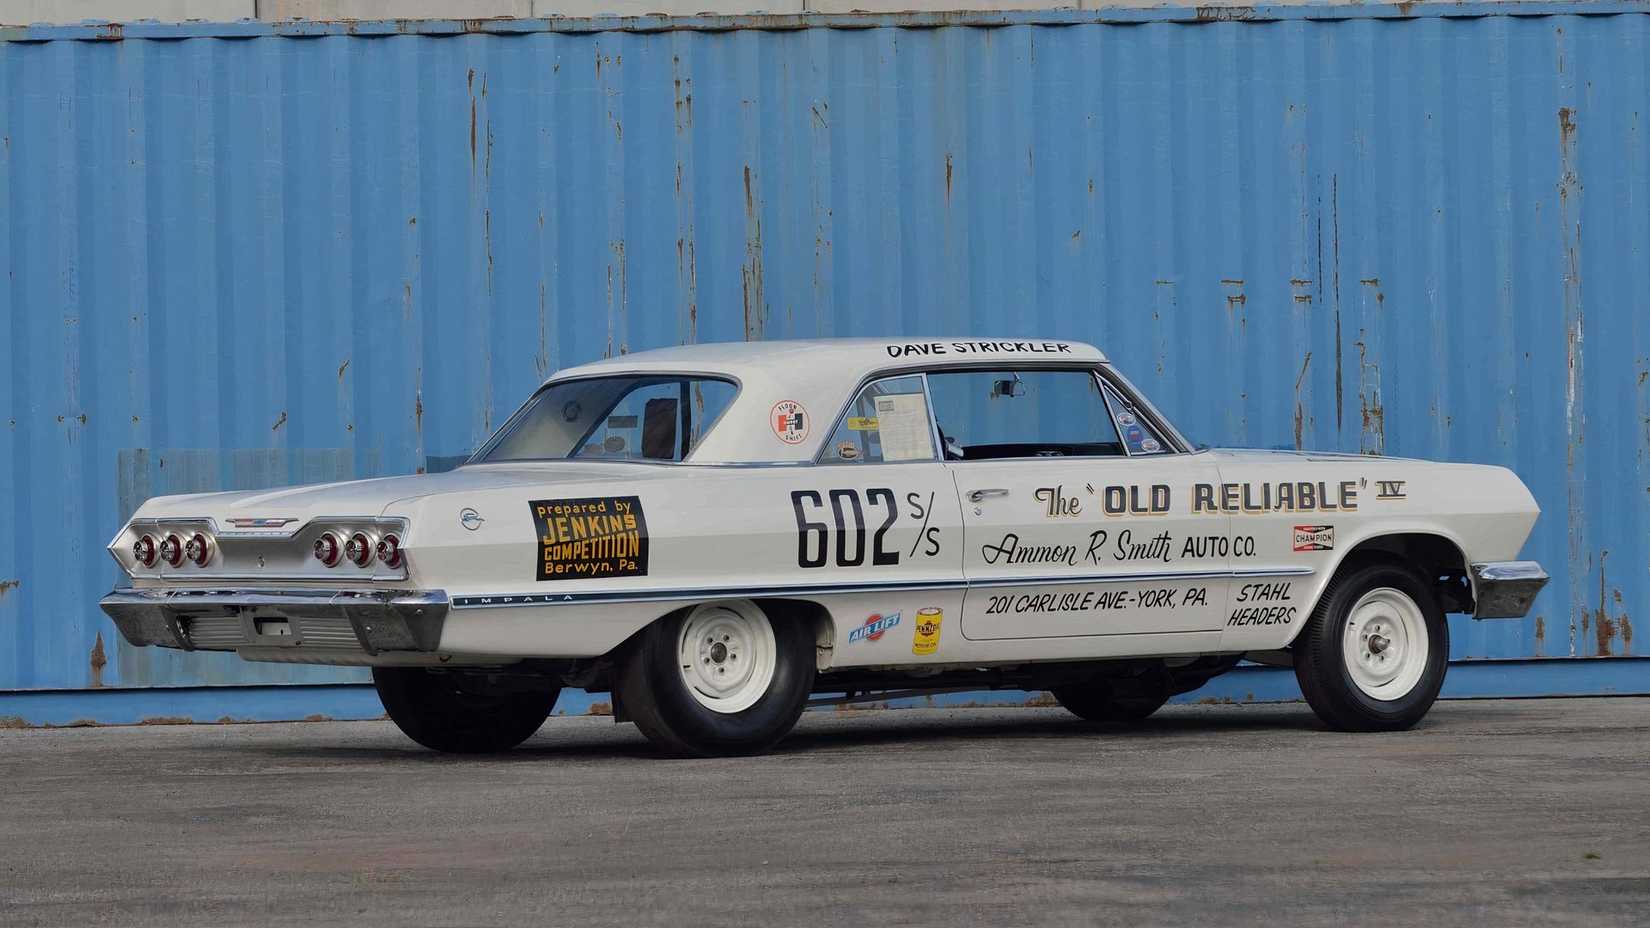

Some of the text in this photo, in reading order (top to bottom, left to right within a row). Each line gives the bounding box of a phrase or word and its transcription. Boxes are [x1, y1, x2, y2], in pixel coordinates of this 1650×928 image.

[887, 342, 1072, 358] DAVE STRICKLER
[537, 500, 631, 518] prepared by
[1034, 485, 1082, 517] The
[1375, 481, 1407, 500] IV
[543, 514, 637, 545] JENKINS
[791, 488, 899, 568] 602
[1296, 533, 1332, 543] CHAMPION
[544, 530, 640, 561] COMPETITION
[982, 529, 1256, 566] Ammon R. Smith AUTO CO.
[619, 560, 639, 570] Pa.
[464, 595, 573, 605] IMPALA
[986, 595, 1015, 614] 201
[1015, 592, 1095, 613] CARLISLE
[1182, 588, 1208, 606] PA.
[1236, 582, 1291, 602] STAHL
[850, 626, 872, 642] AIR
[873, 613, 901, 633] LIFT
[1227, 606, 1297, 627] HEADERS
